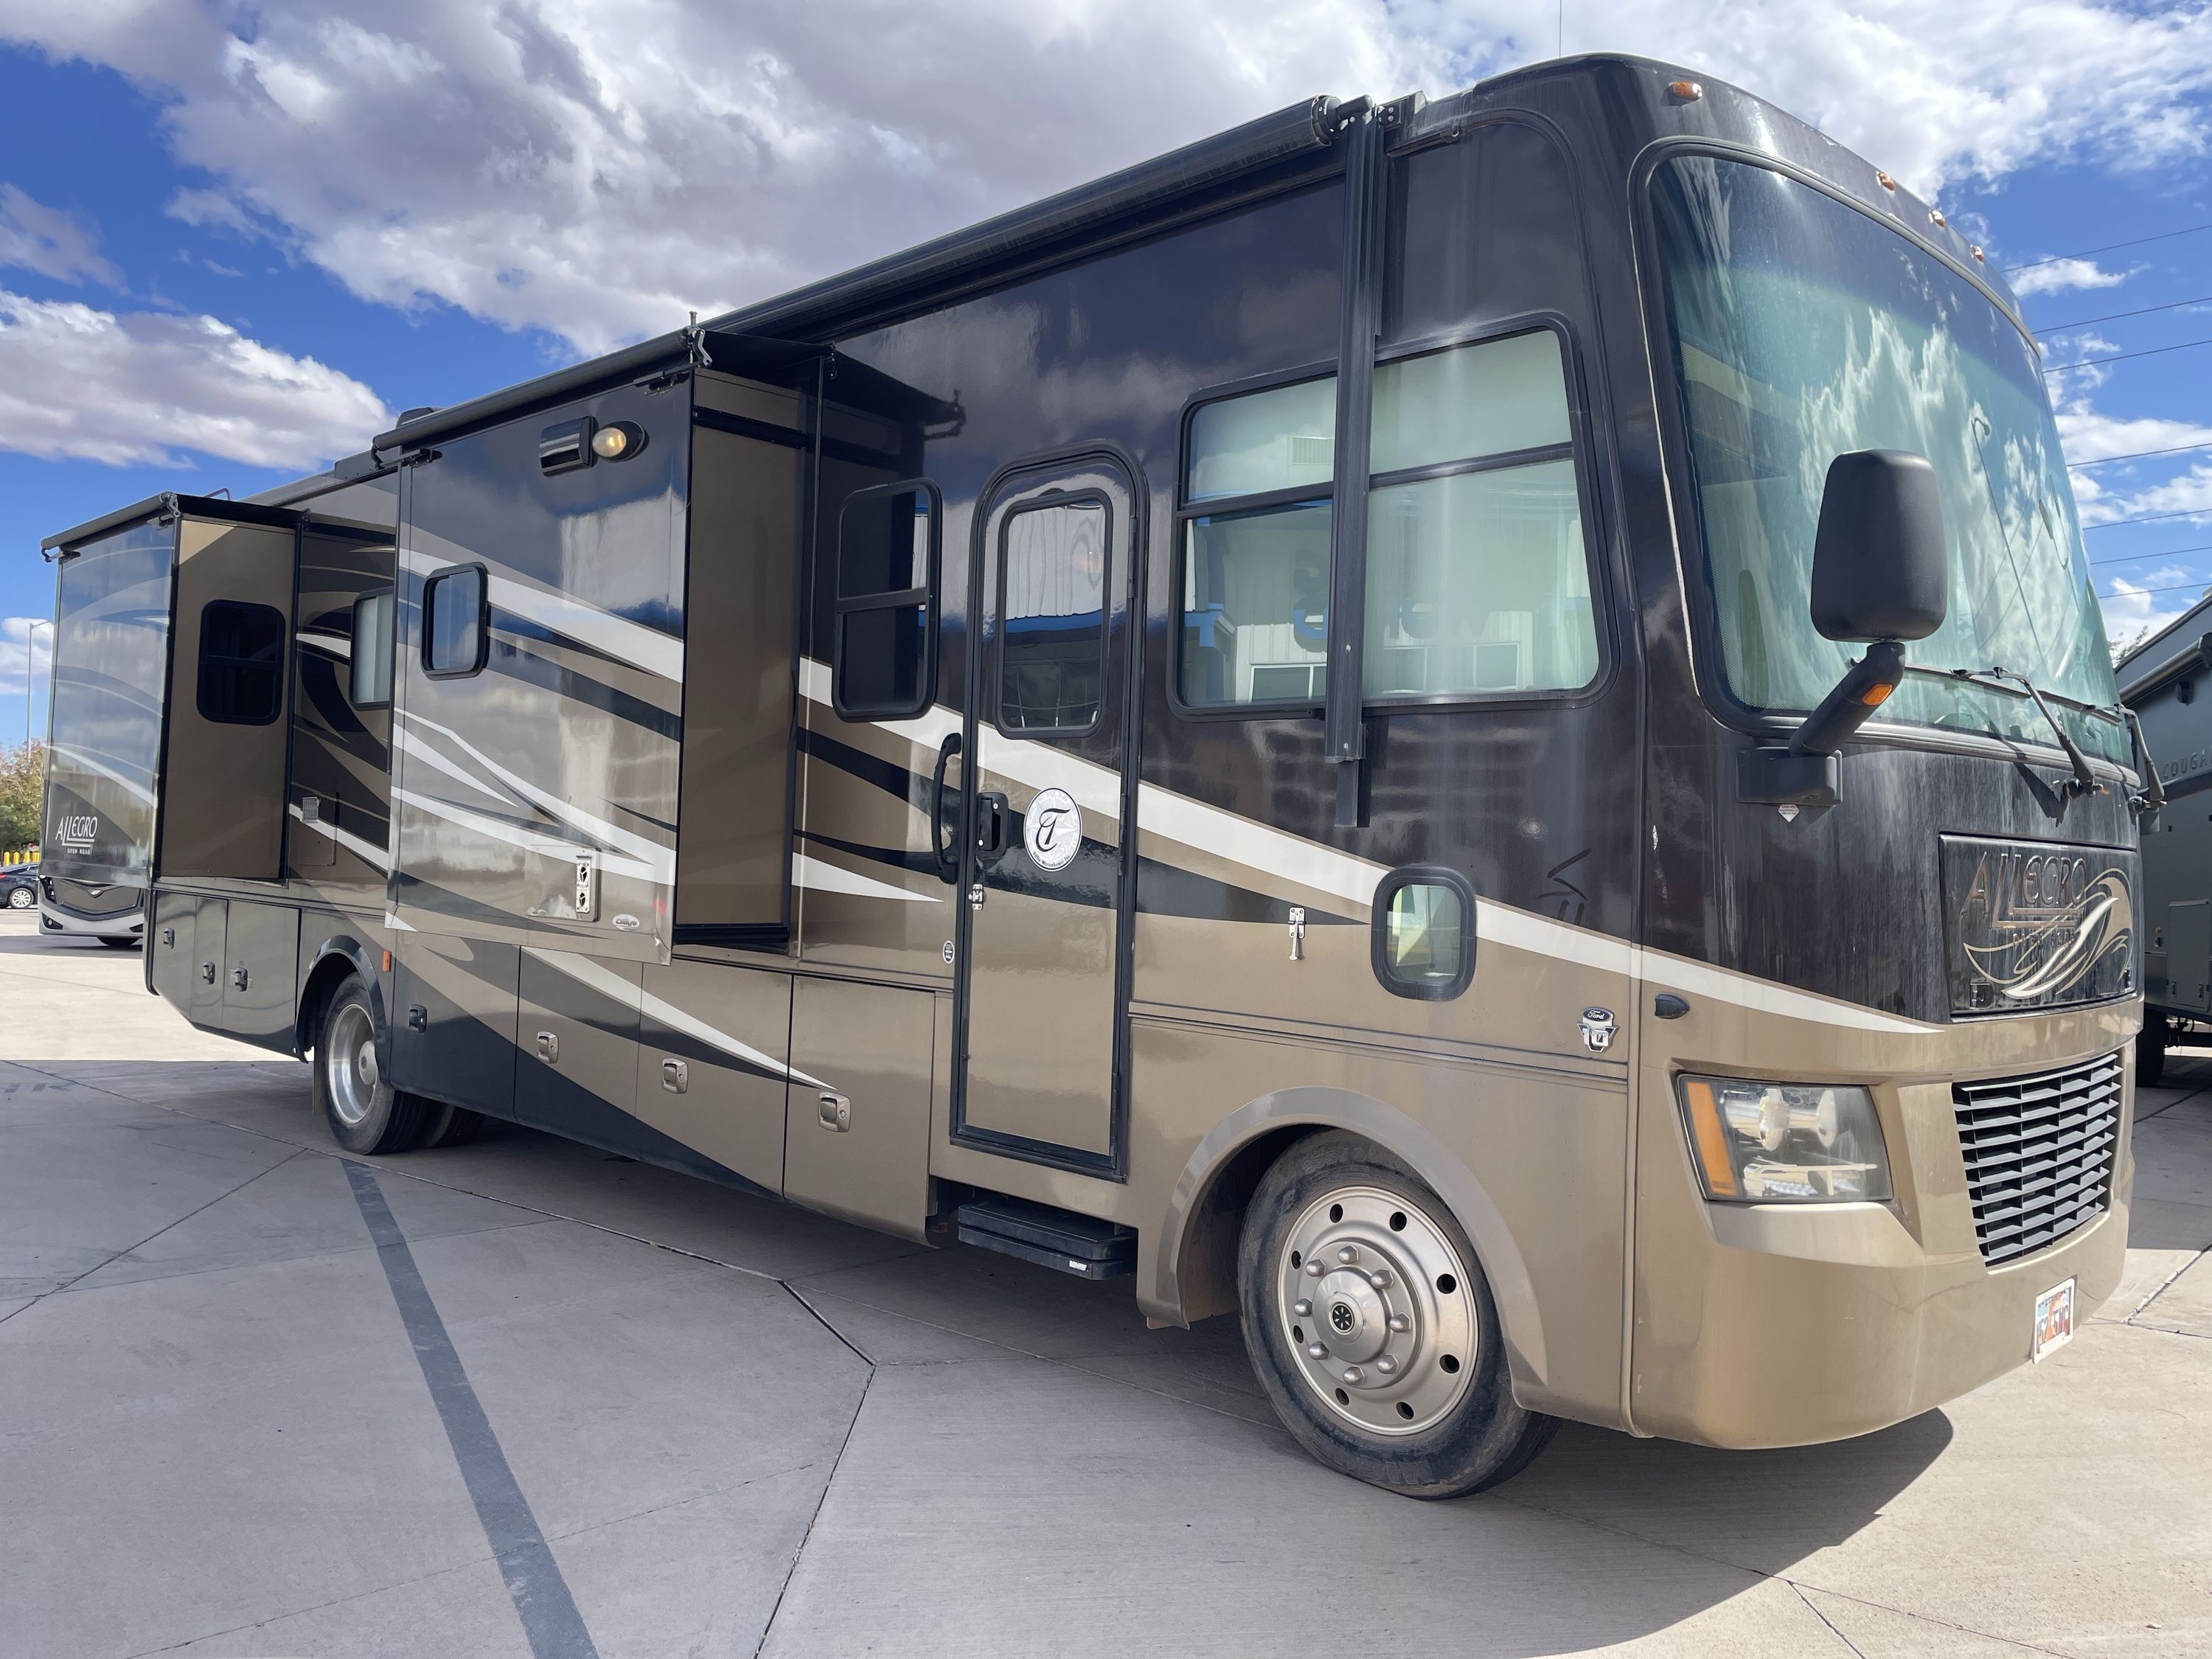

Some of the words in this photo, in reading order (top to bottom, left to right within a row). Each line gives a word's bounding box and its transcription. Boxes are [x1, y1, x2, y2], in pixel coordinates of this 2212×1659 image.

[2163, 746, 2212, 779] COUGA
[55, 815, 97, 847] ALLEGRO
[1961, 851, 2087, 929] ALLEGRO
[1587, 1010, 1605, 1020] Ford
